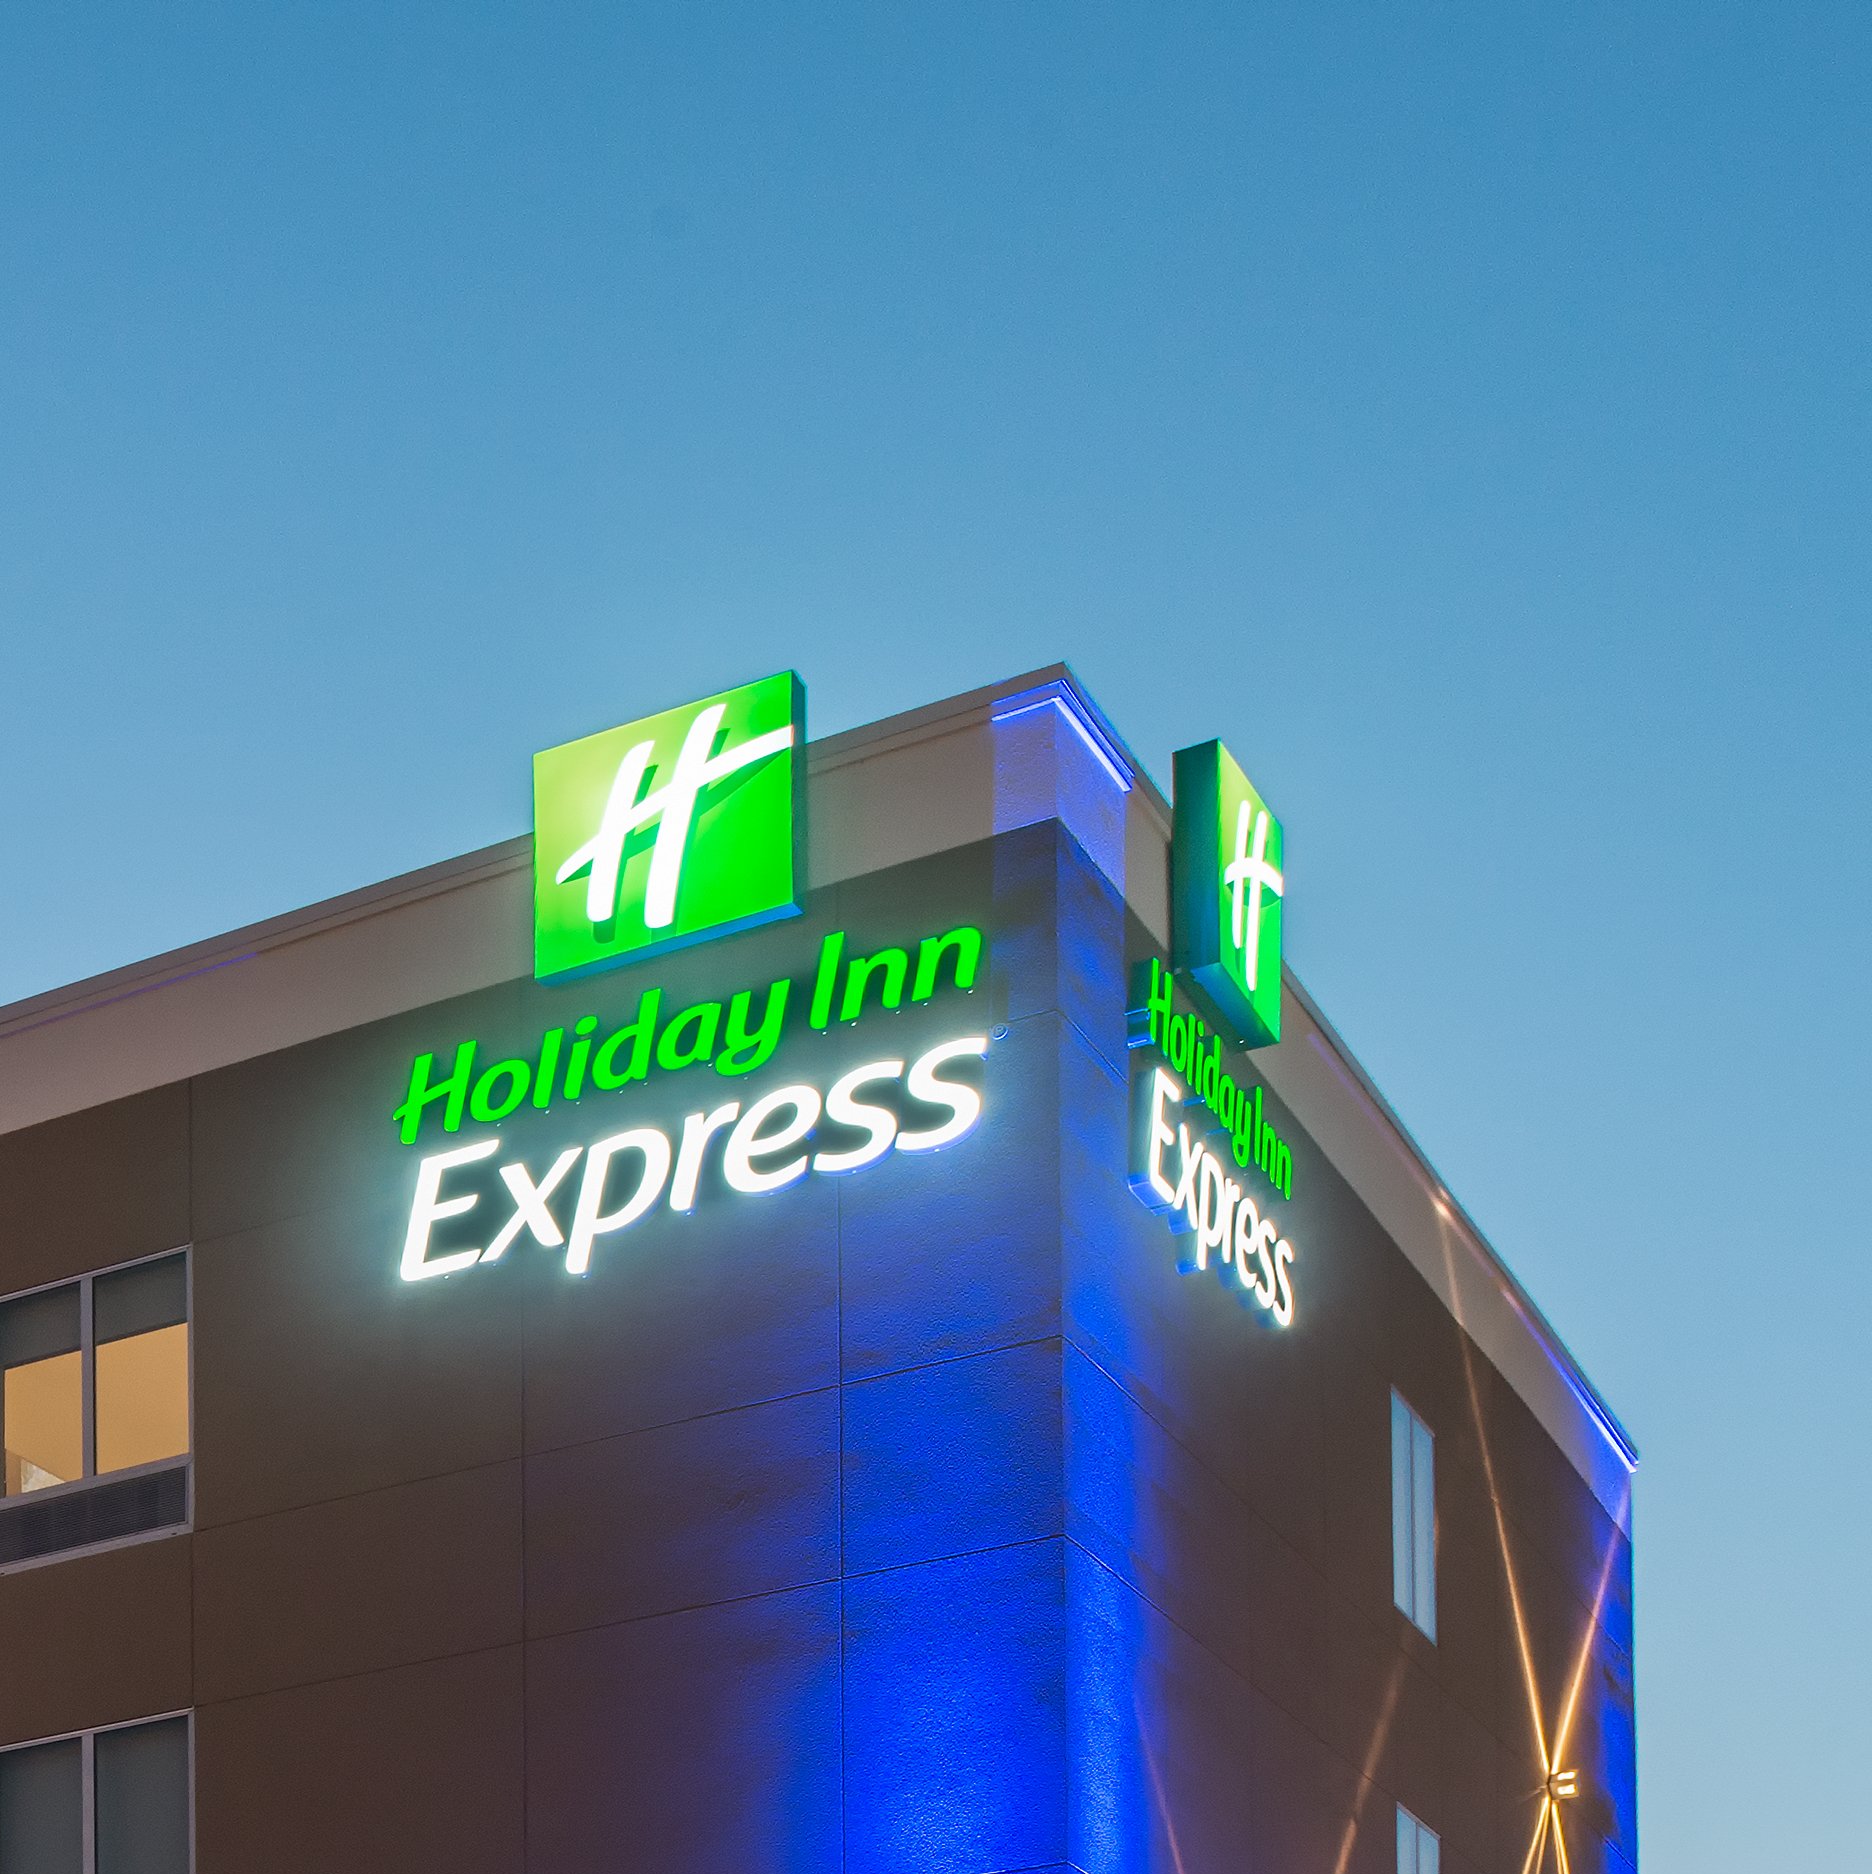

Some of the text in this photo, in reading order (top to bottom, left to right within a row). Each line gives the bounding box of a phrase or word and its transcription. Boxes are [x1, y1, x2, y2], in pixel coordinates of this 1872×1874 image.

[393, 926, 983, 1145] Holiday Inn
[1148, 957, 1292, 1201] Holiday Inn
[400, 1036, 988, 1282] Express
[1149, 1067, 1295, 1328] Express
